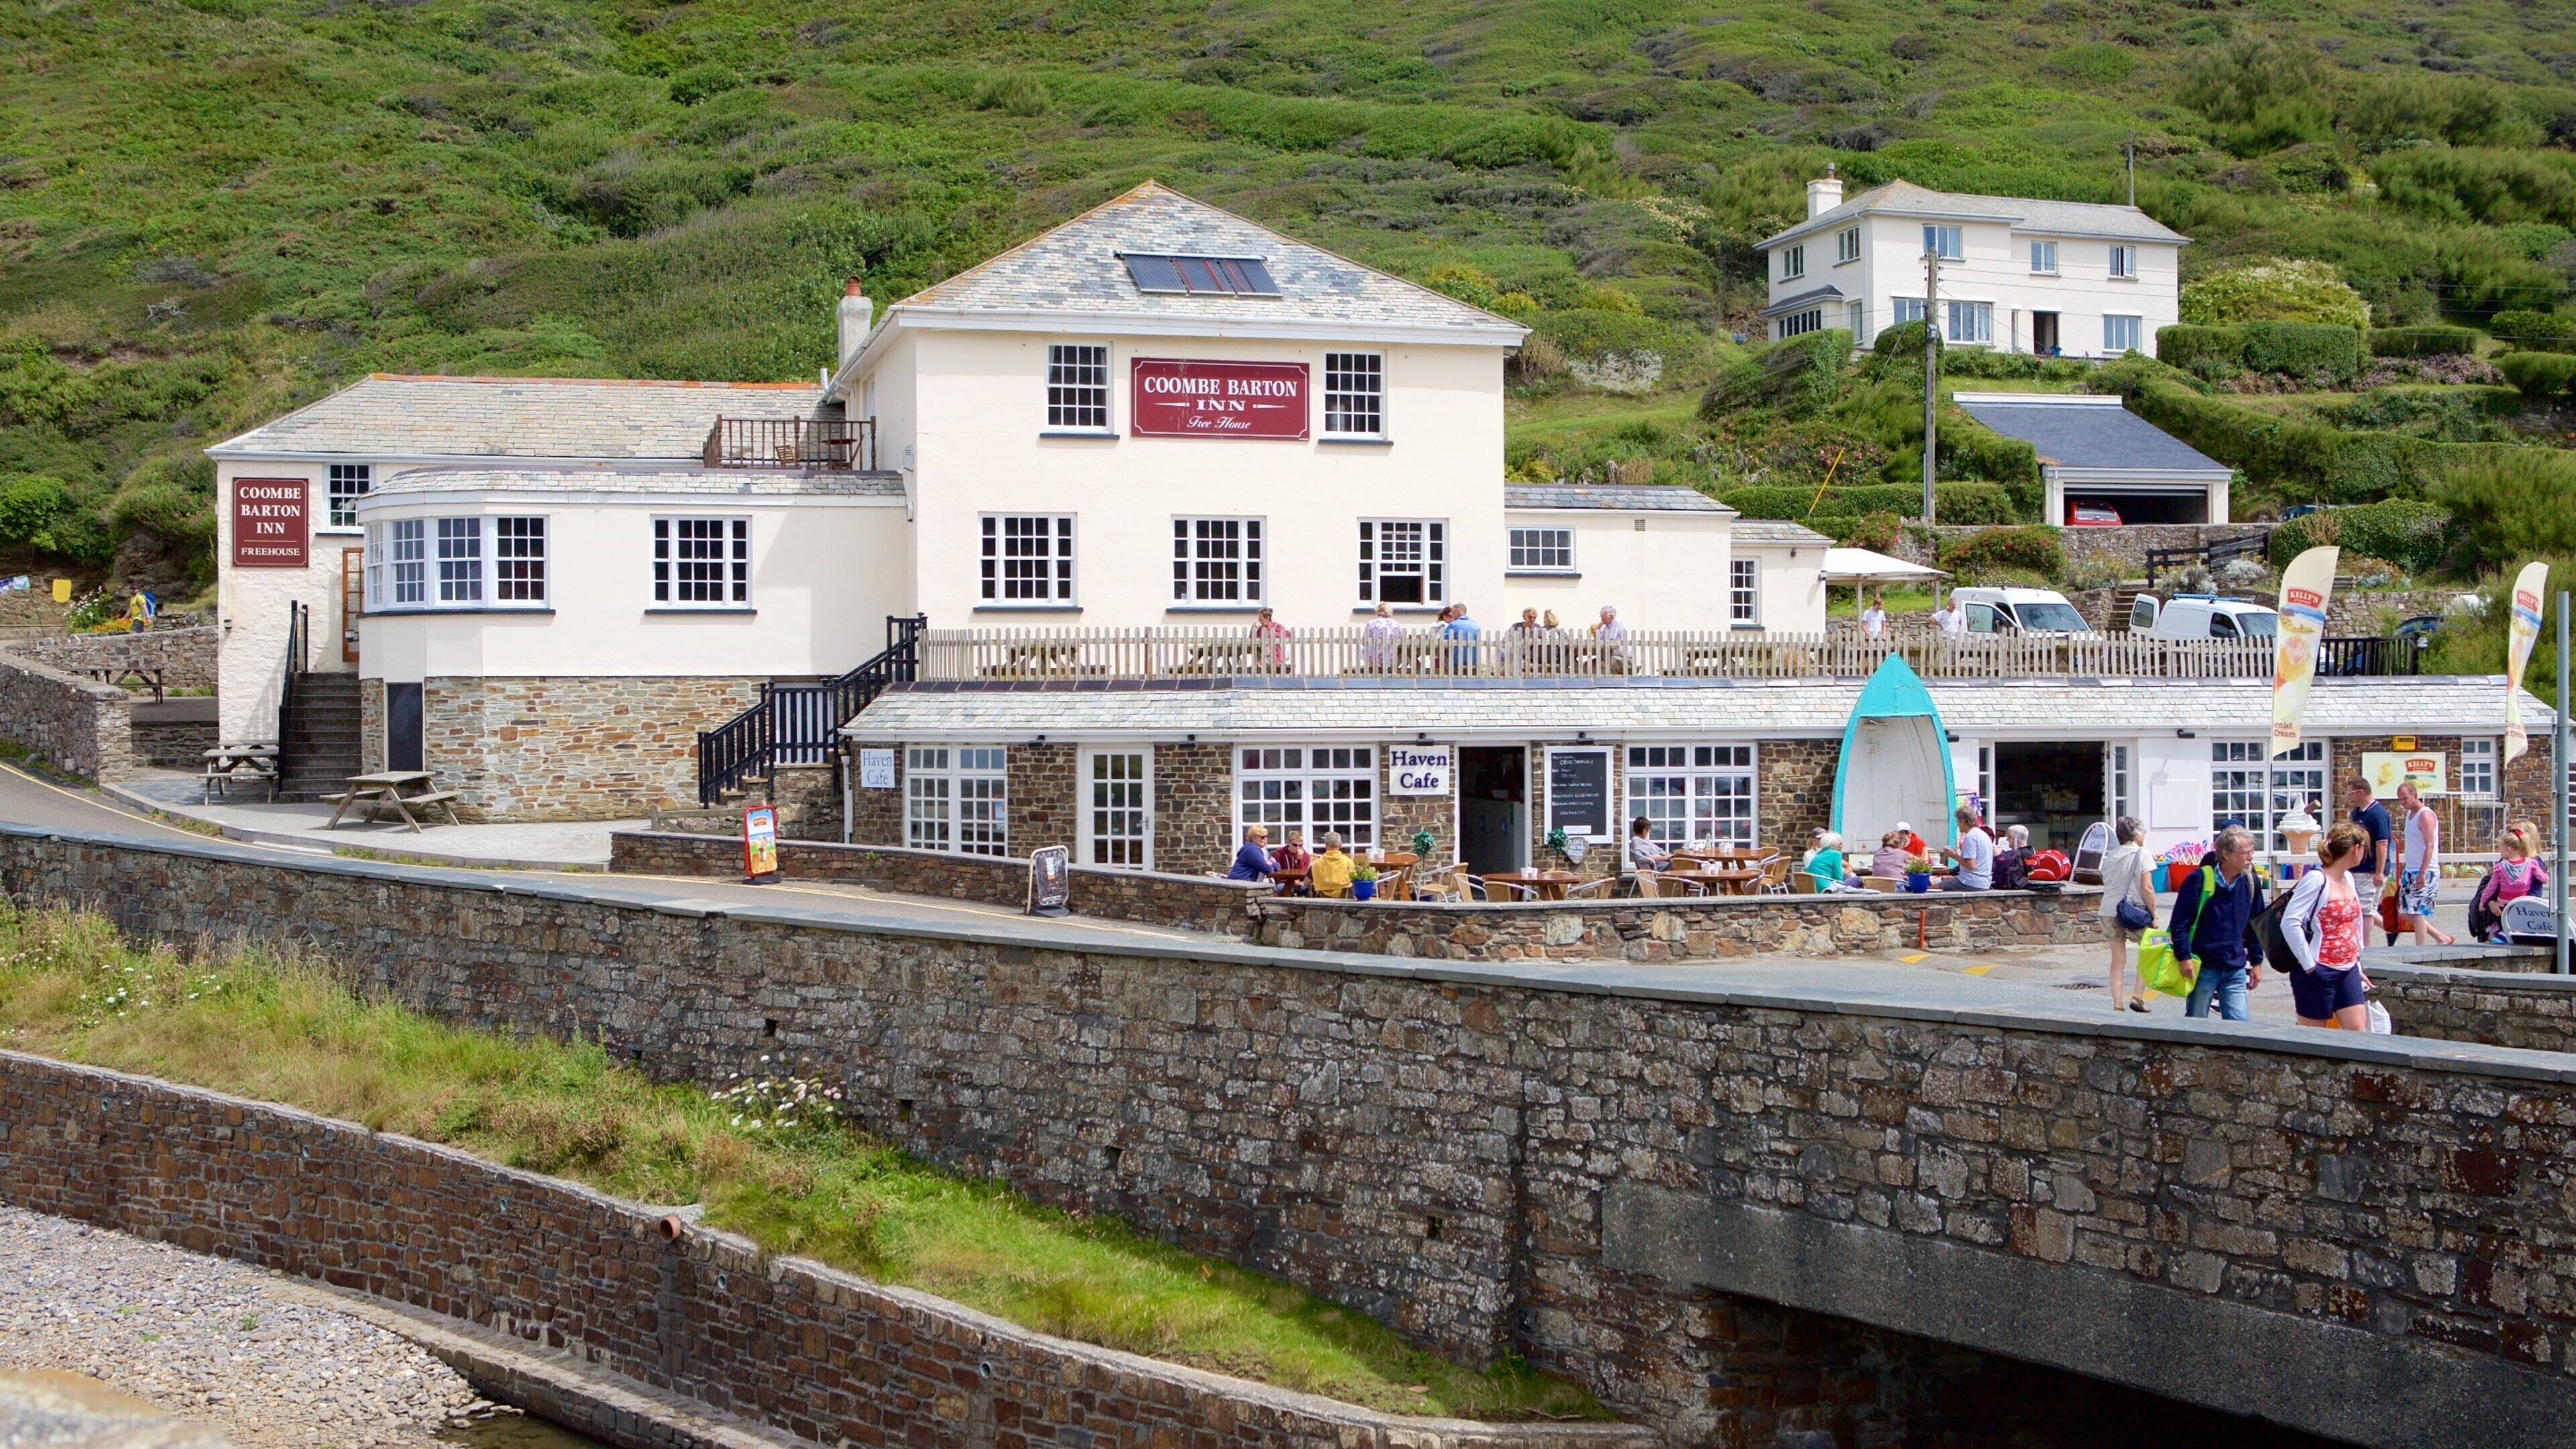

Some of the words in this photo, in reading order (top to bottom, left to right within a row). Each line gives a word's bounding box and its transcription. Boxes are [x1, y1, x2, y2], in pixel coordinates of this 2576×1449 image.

[1144, 376, 1220, 395] COOMBE
[1227, 379, 1298, 397] BARTON
[1196, 399, 1246, 412] INN
[1187, 415, 1212, 429] Free
[1214, 416, 1252, 429] House
[239, 486, 301, 499] COOMBE
[240, 504, 301, 517] BARTON
[256, 522, 285, 534] INN
[241, 547, 301, 556] FREEHOUSE
[2290, 591, 2319, 604] KELLY'S
[2274, 730, 2296, 738] Cream
[863, 751, 893, 767] Haven
[1391, 751, 1448, 766] Haven
[867, 769, 888, 785] Cafe
[1400, 772, 1439, 788] Cafe
[2090, 831, 2106, 839] Haven
[2527, 920, 2555, 931] Café
